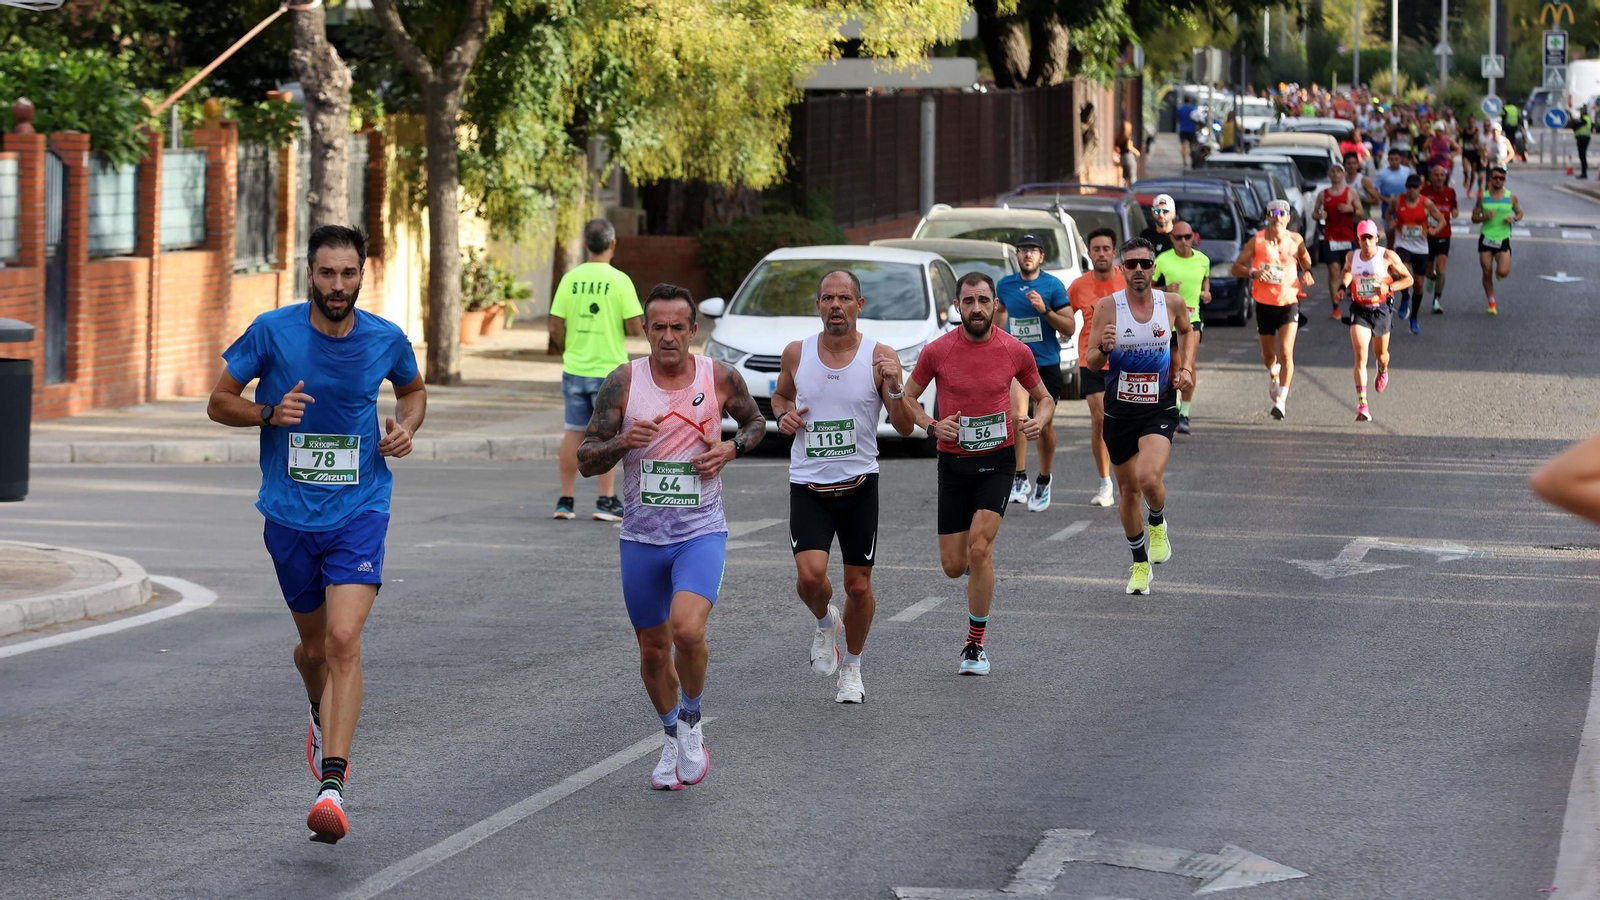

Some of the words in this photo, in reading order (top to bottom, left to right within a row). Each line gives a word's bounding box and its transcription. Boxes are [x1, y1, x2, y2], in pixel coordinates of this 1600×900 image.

[572, 282, 610, 295] STAFF
[1019, 327, 1030, 335] 60
[1127, 383, 1149, 393] 210
[816, 432, 844, 447] 118
[975, 427, 991, 440] 56
[312, 451, 336, 468] 78
[659, 476, 681, 492] 64
